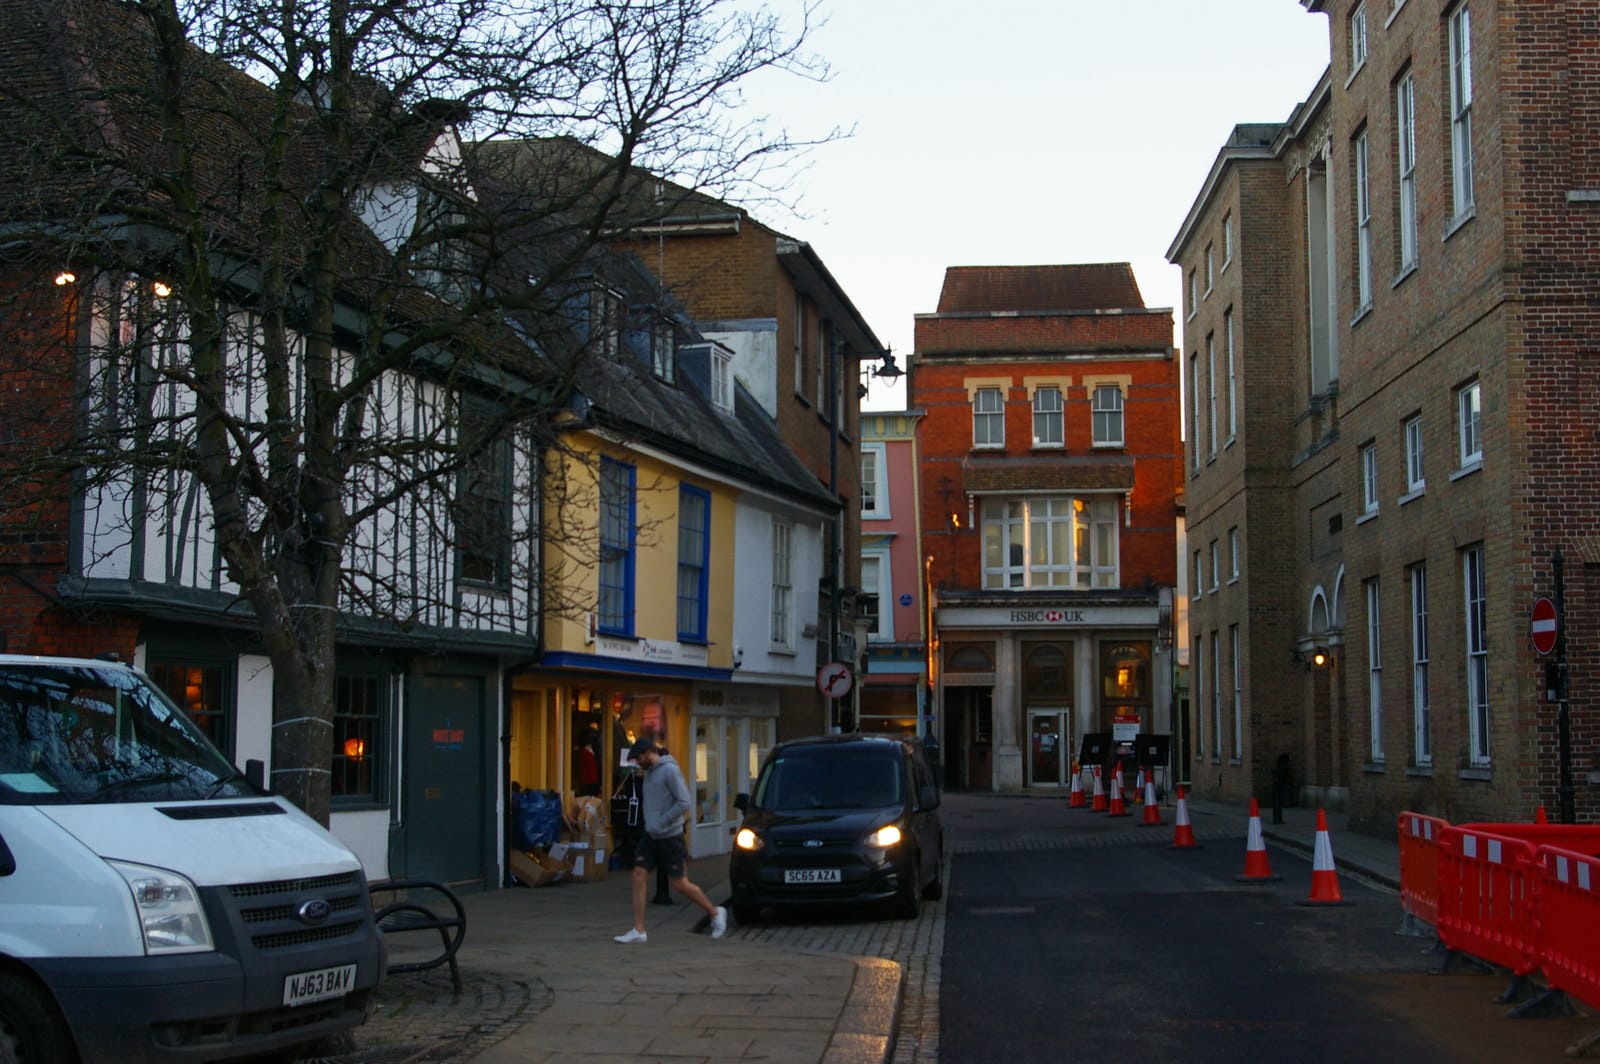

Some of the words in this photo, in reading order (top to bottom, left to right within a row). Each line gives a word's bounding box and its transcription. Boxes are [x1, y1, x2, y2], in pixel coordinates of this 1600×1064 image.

[1011, 611, 1045, 623] HSBC
[1065, 611, 1084, 623] UK
[788, 871, 815, 881] SC65
[818, 871, 836, 881] AZA
[291, 974, 323, 998] NJ63
[327, 969, 352, 990] BAV
